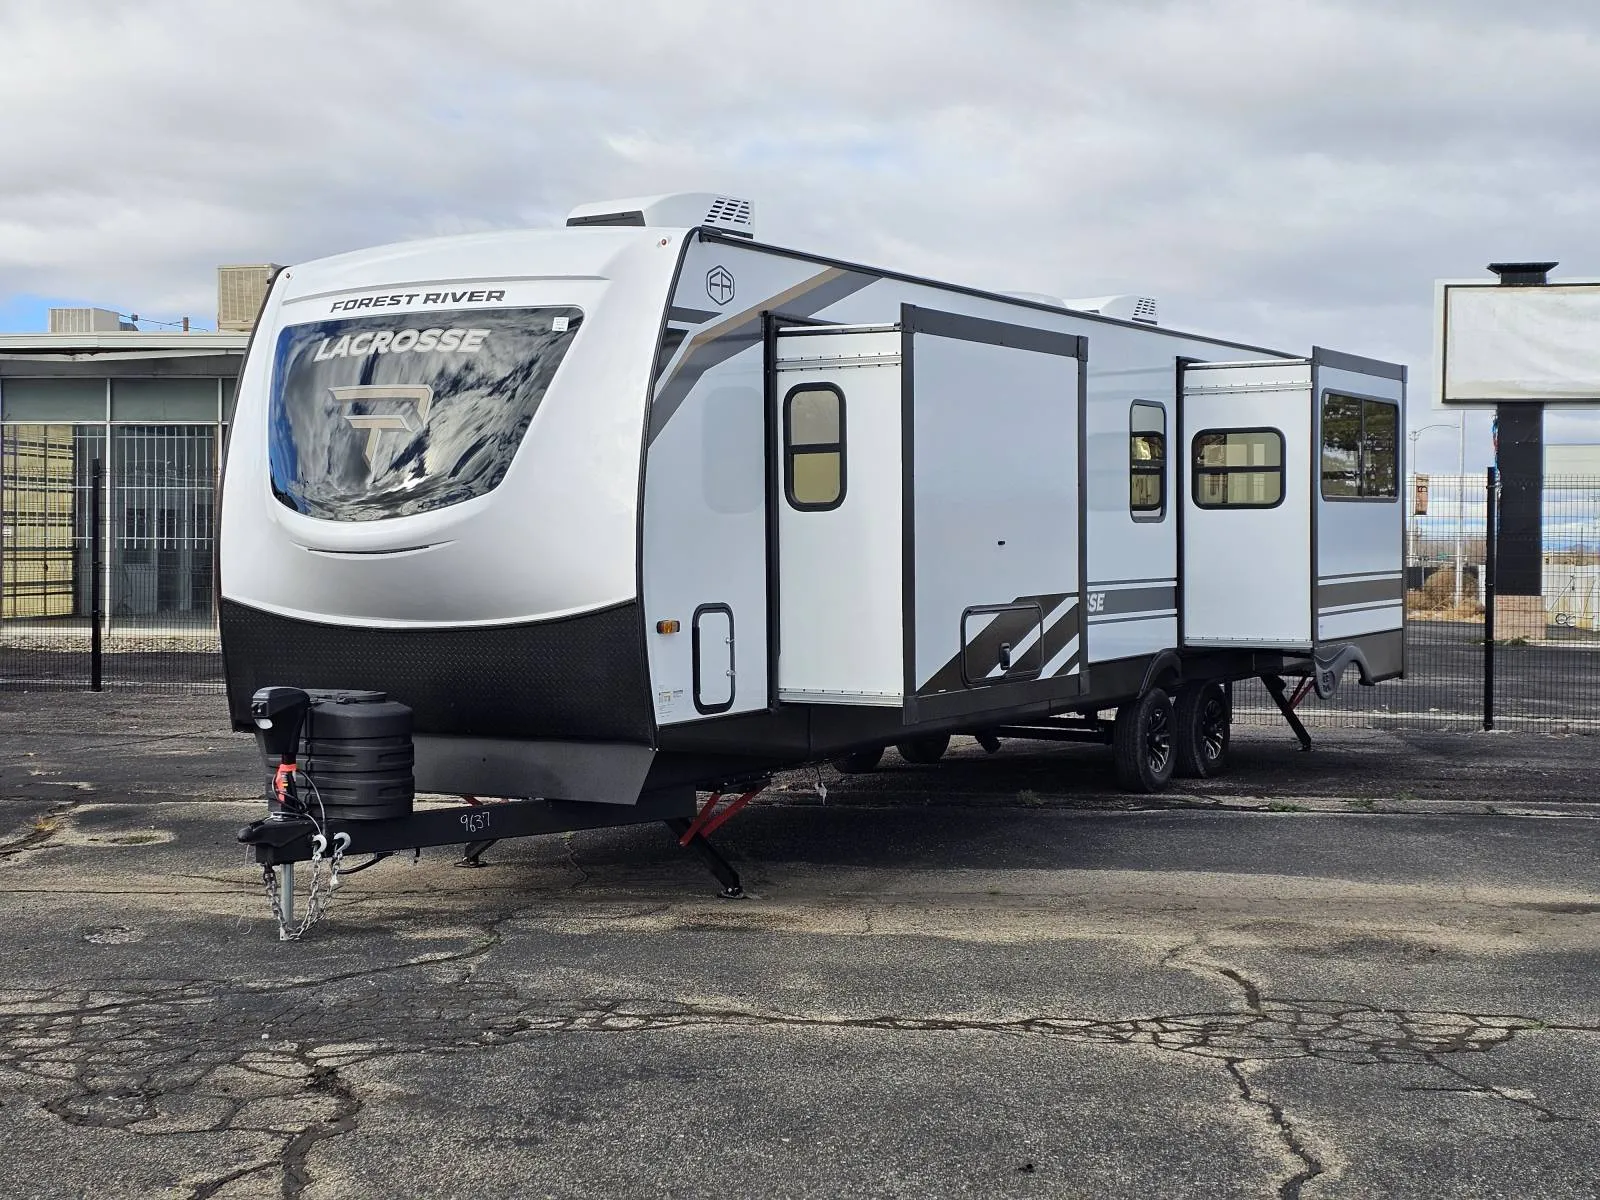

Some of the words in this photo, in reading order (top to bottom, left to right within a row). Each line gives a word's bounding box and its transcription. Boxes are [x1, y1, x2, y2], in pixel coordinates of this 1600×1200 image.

[330, 293, 420, 313] FOREST
[423, 290, 506, 304] RIVER
[313, 328, 491, 362] LACROSSE
[460, 811, 490, 833] 9637
